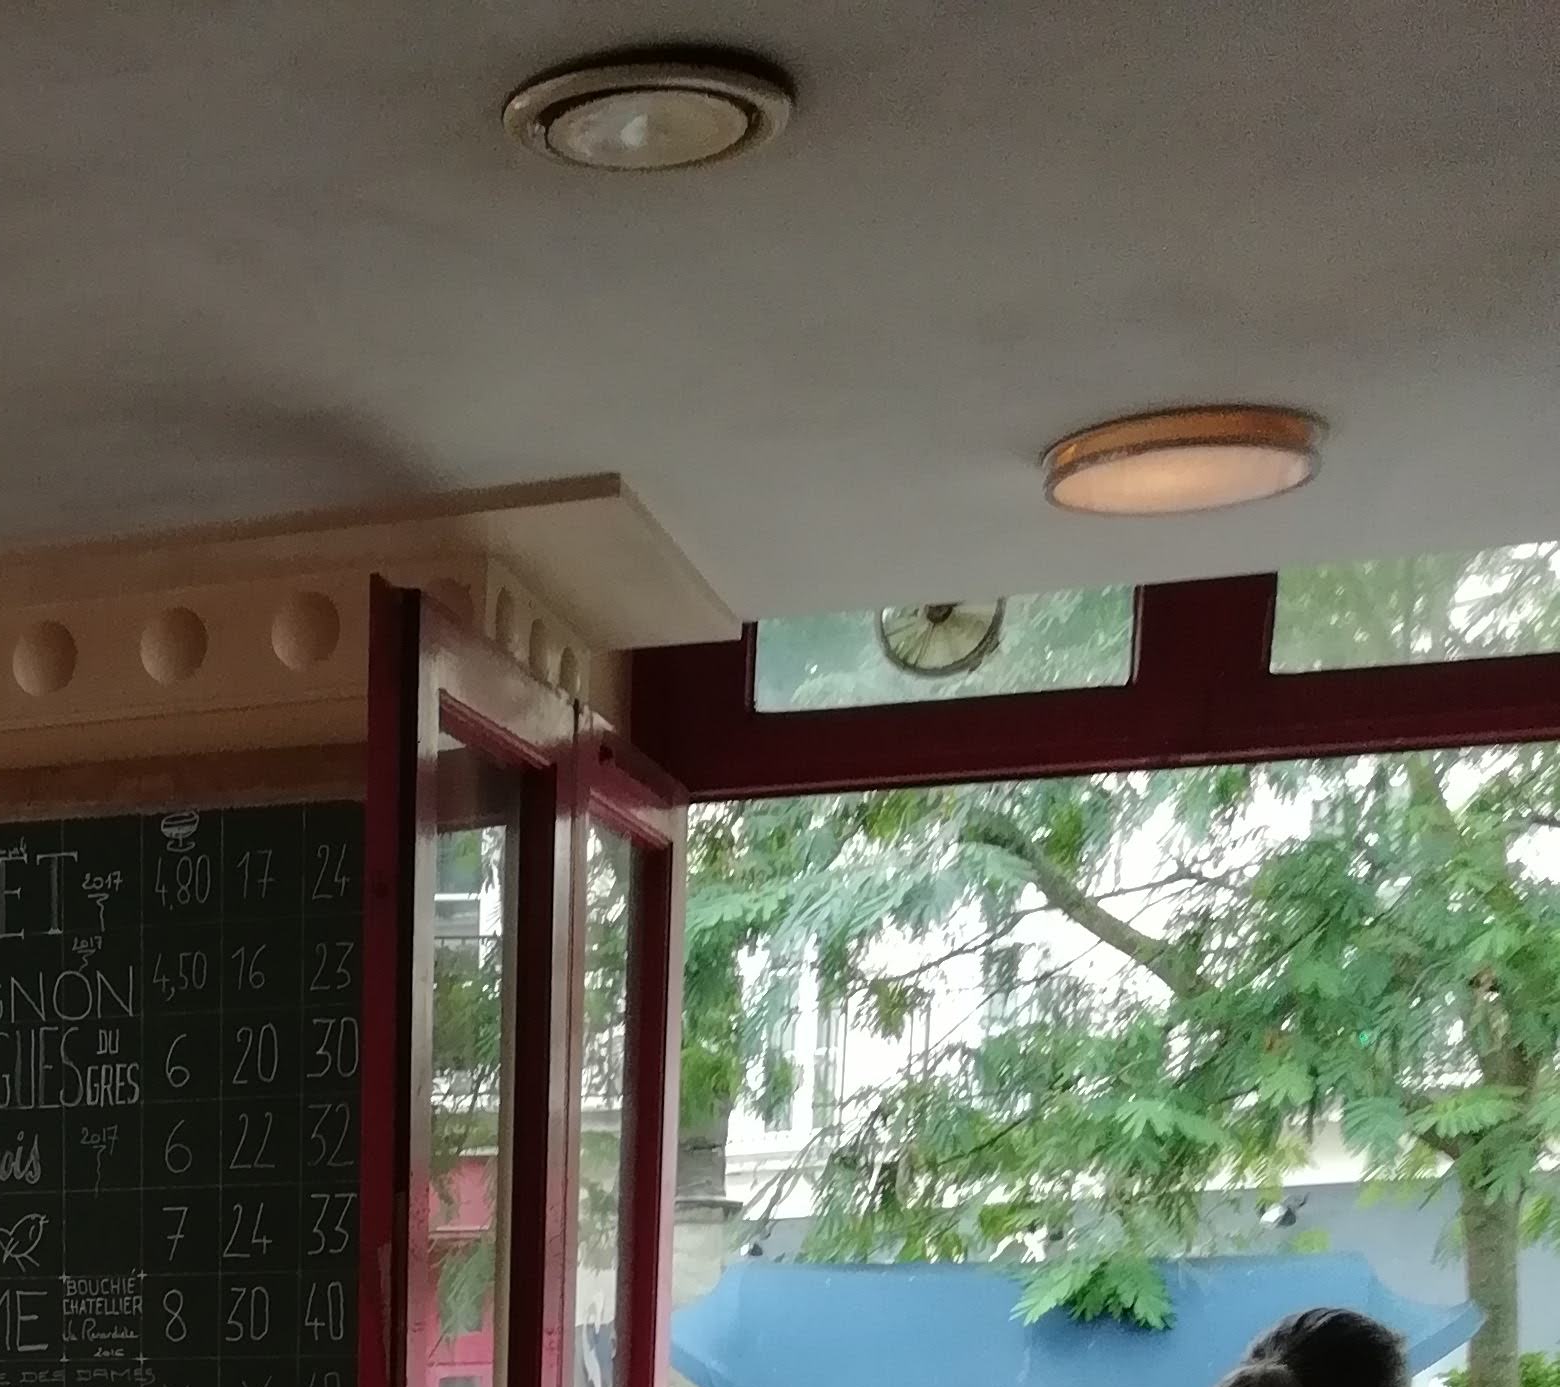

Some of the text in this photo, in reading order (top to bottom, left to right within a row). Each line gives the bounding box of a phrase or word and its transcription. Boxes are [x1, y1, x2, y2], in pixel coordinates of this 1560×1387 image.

[81, 870, 124, 893] 2017
[238, 849, 274, 901] 17
[311, 844, 350, 900] 24
[71, 935, 104, 951] 2017
[232, 944, 267, 989] 16
[309, 942, 355, 992] 23
[96, 1028, 120, 1056] DU
[166, 1032, 191, 1088] 6
[232, 1022, 280, 1084] 20
[305, 1016, 360, 1079] 30
[85, 1062, 141, 1108] GRES
[79, 1123, 120, 1156] 2017
[164, 1118, 193, 1174] 6
[229, 1112, 277, 1169] 22
[306, 1103, 356, 1168] 32
[161, 1206, 191, 1261] 7
[222, 1202, 273, 1259] 24
[306, 1193, 358, 1256] 33
[62, 1296, 143, 1317] CHATELLIER
[65, 1267, 137, 1297] BOUCHIÉ
[162, 1288, 188, 1343] 8
[224, 1286, 270, 1343] 30
[304, 1281, 345, 1342] 40
[19, 1369, 66, 1384] DES
[75, 1368, 157, 1386] DAMES
